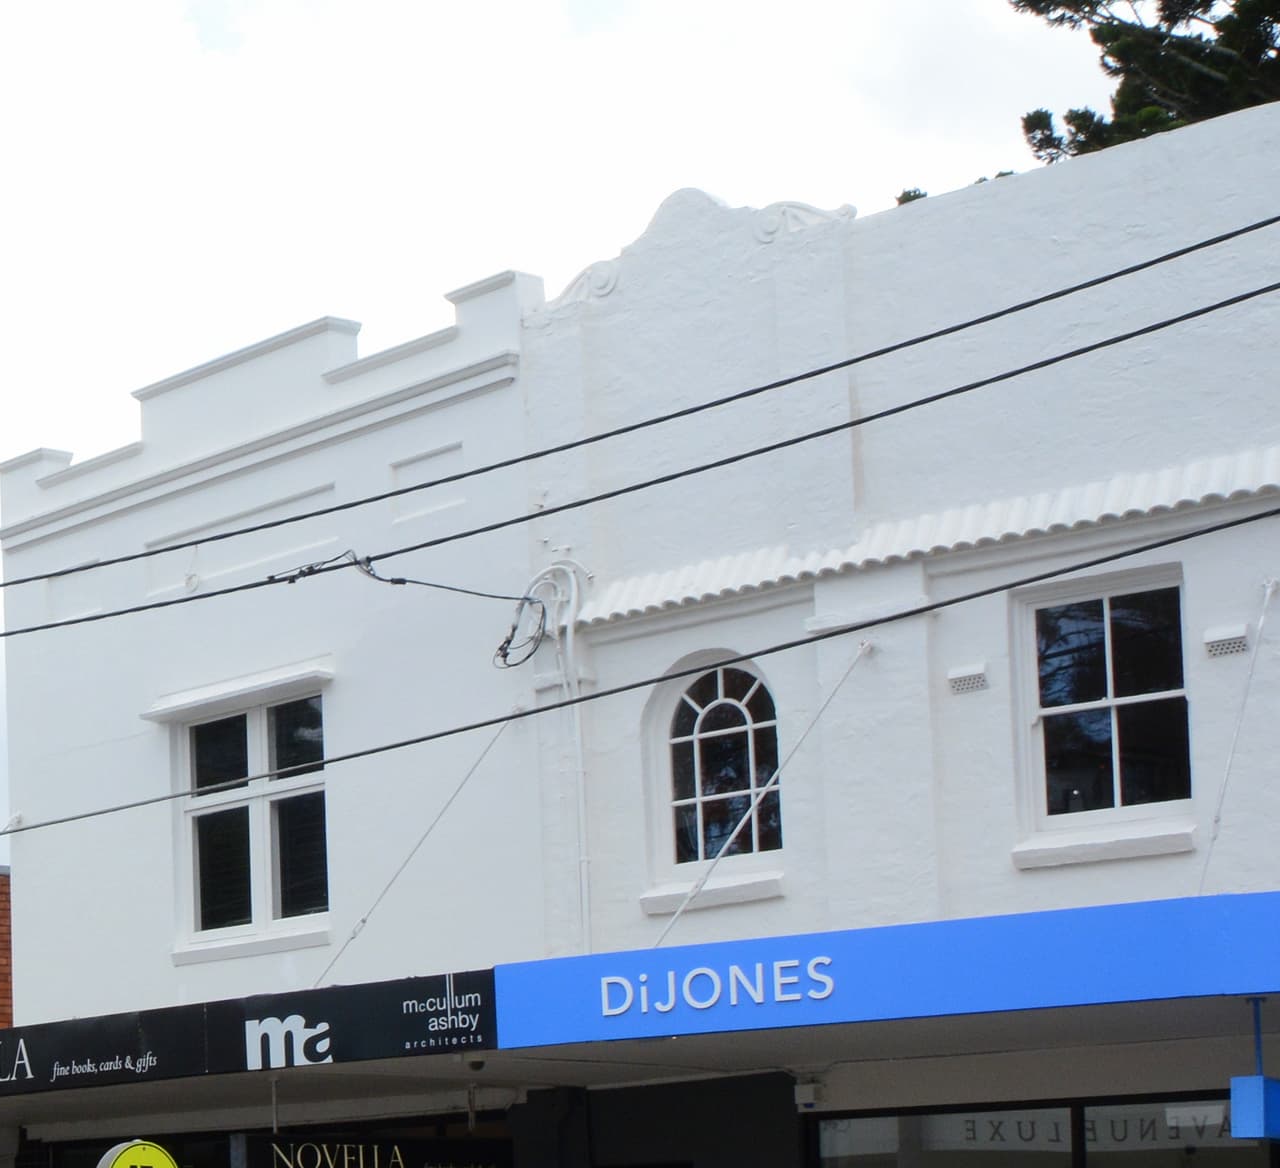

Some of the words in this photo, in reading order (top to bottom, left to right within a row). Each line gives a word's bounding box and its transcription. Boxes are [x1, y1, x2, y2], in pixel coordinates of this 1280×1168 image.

[601, 956, 835, 1017] DiJONES
[428, 1012, 480, 1032] ashby
[245, 1014, 334, 1071] ma
[404, 1034, 483, 1050] architects
[50, 1061, 70, 1082] fine
[71, 1055, 98, 1076] books,
[99, 1056, 122, 1071] cards
[124, 1055, 135, 1070] &
[136, 1051, 157, 1073] gifts
